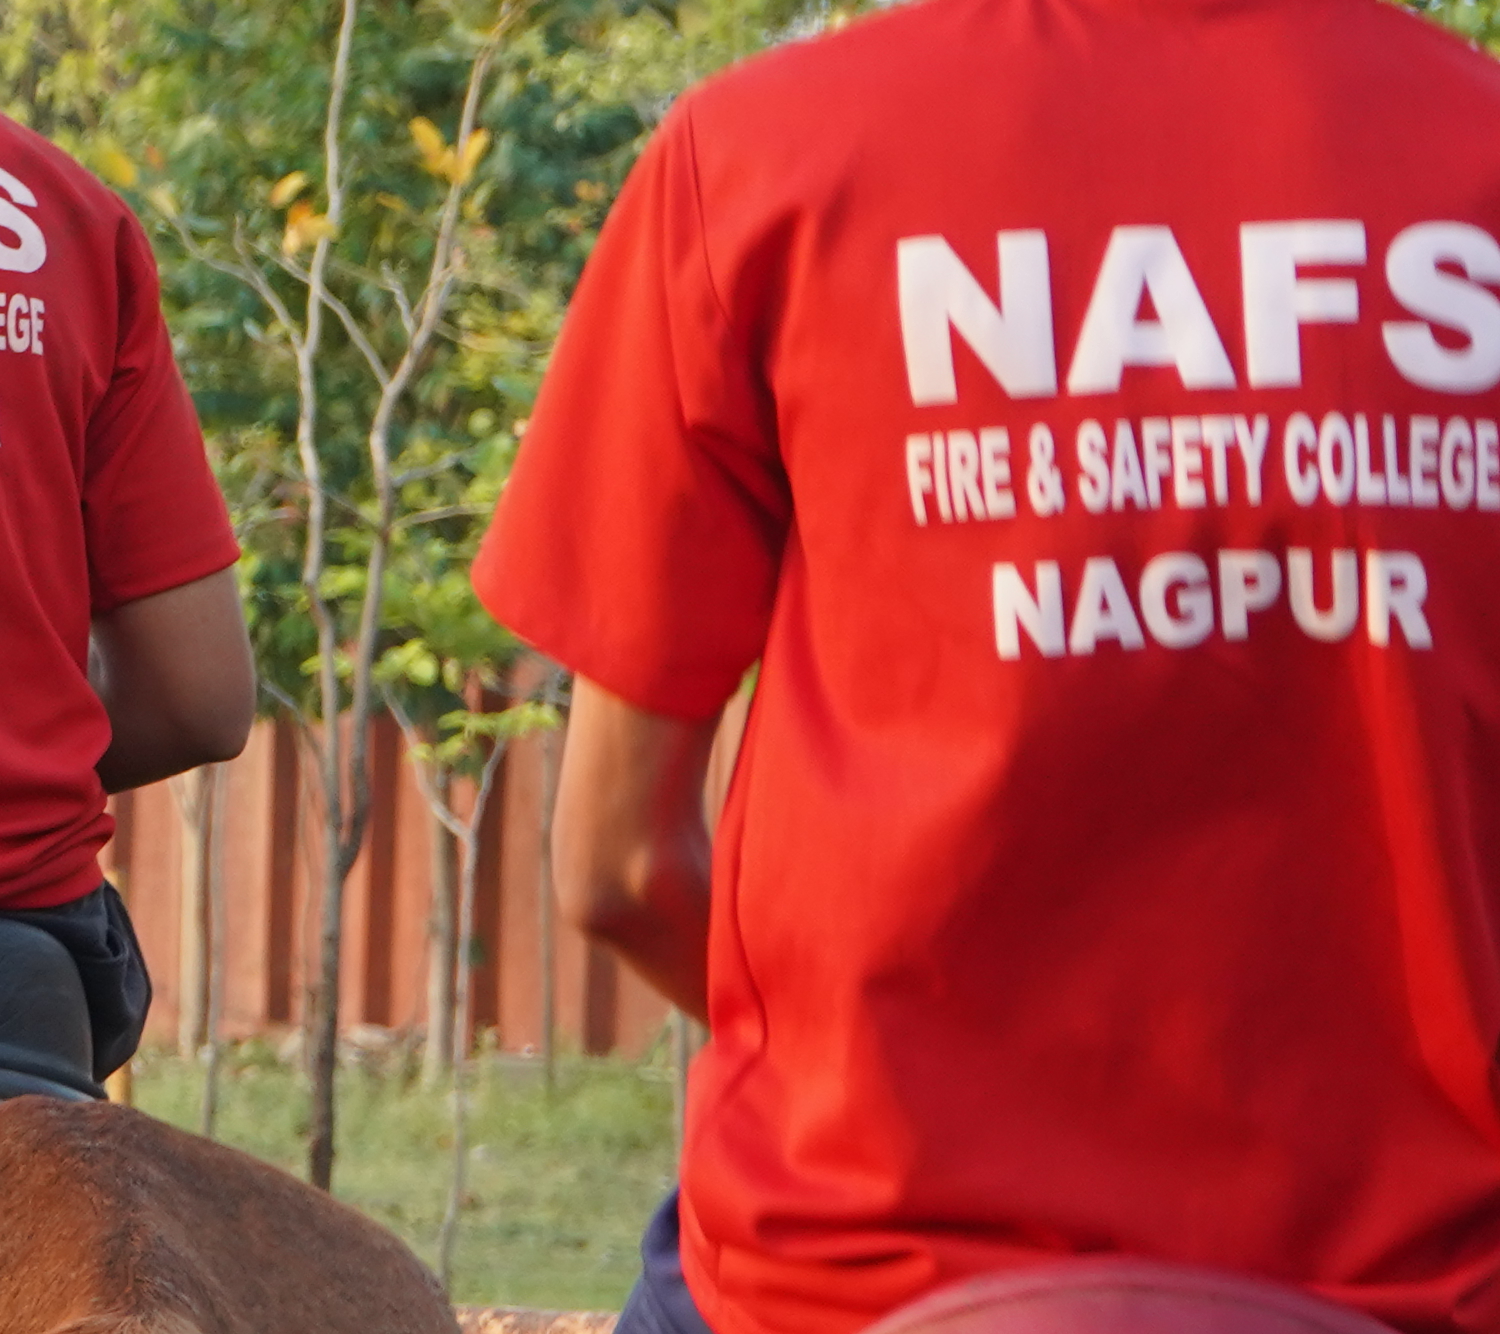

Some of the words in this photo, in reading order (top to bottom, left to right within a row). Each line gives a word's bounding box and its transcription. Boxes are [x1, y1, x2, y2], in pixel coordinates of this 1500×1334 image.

[897, 219, 1500, 406] NAFS
[906, 427, 1015, 525] FIRE
[1027, 423, 1064, 516] &
[1076, 414, 1268, 512] SAFETY
[1284, 412, 1500, 508] COLLEGE
[992, 550, 1431, 659] NAGPUR
